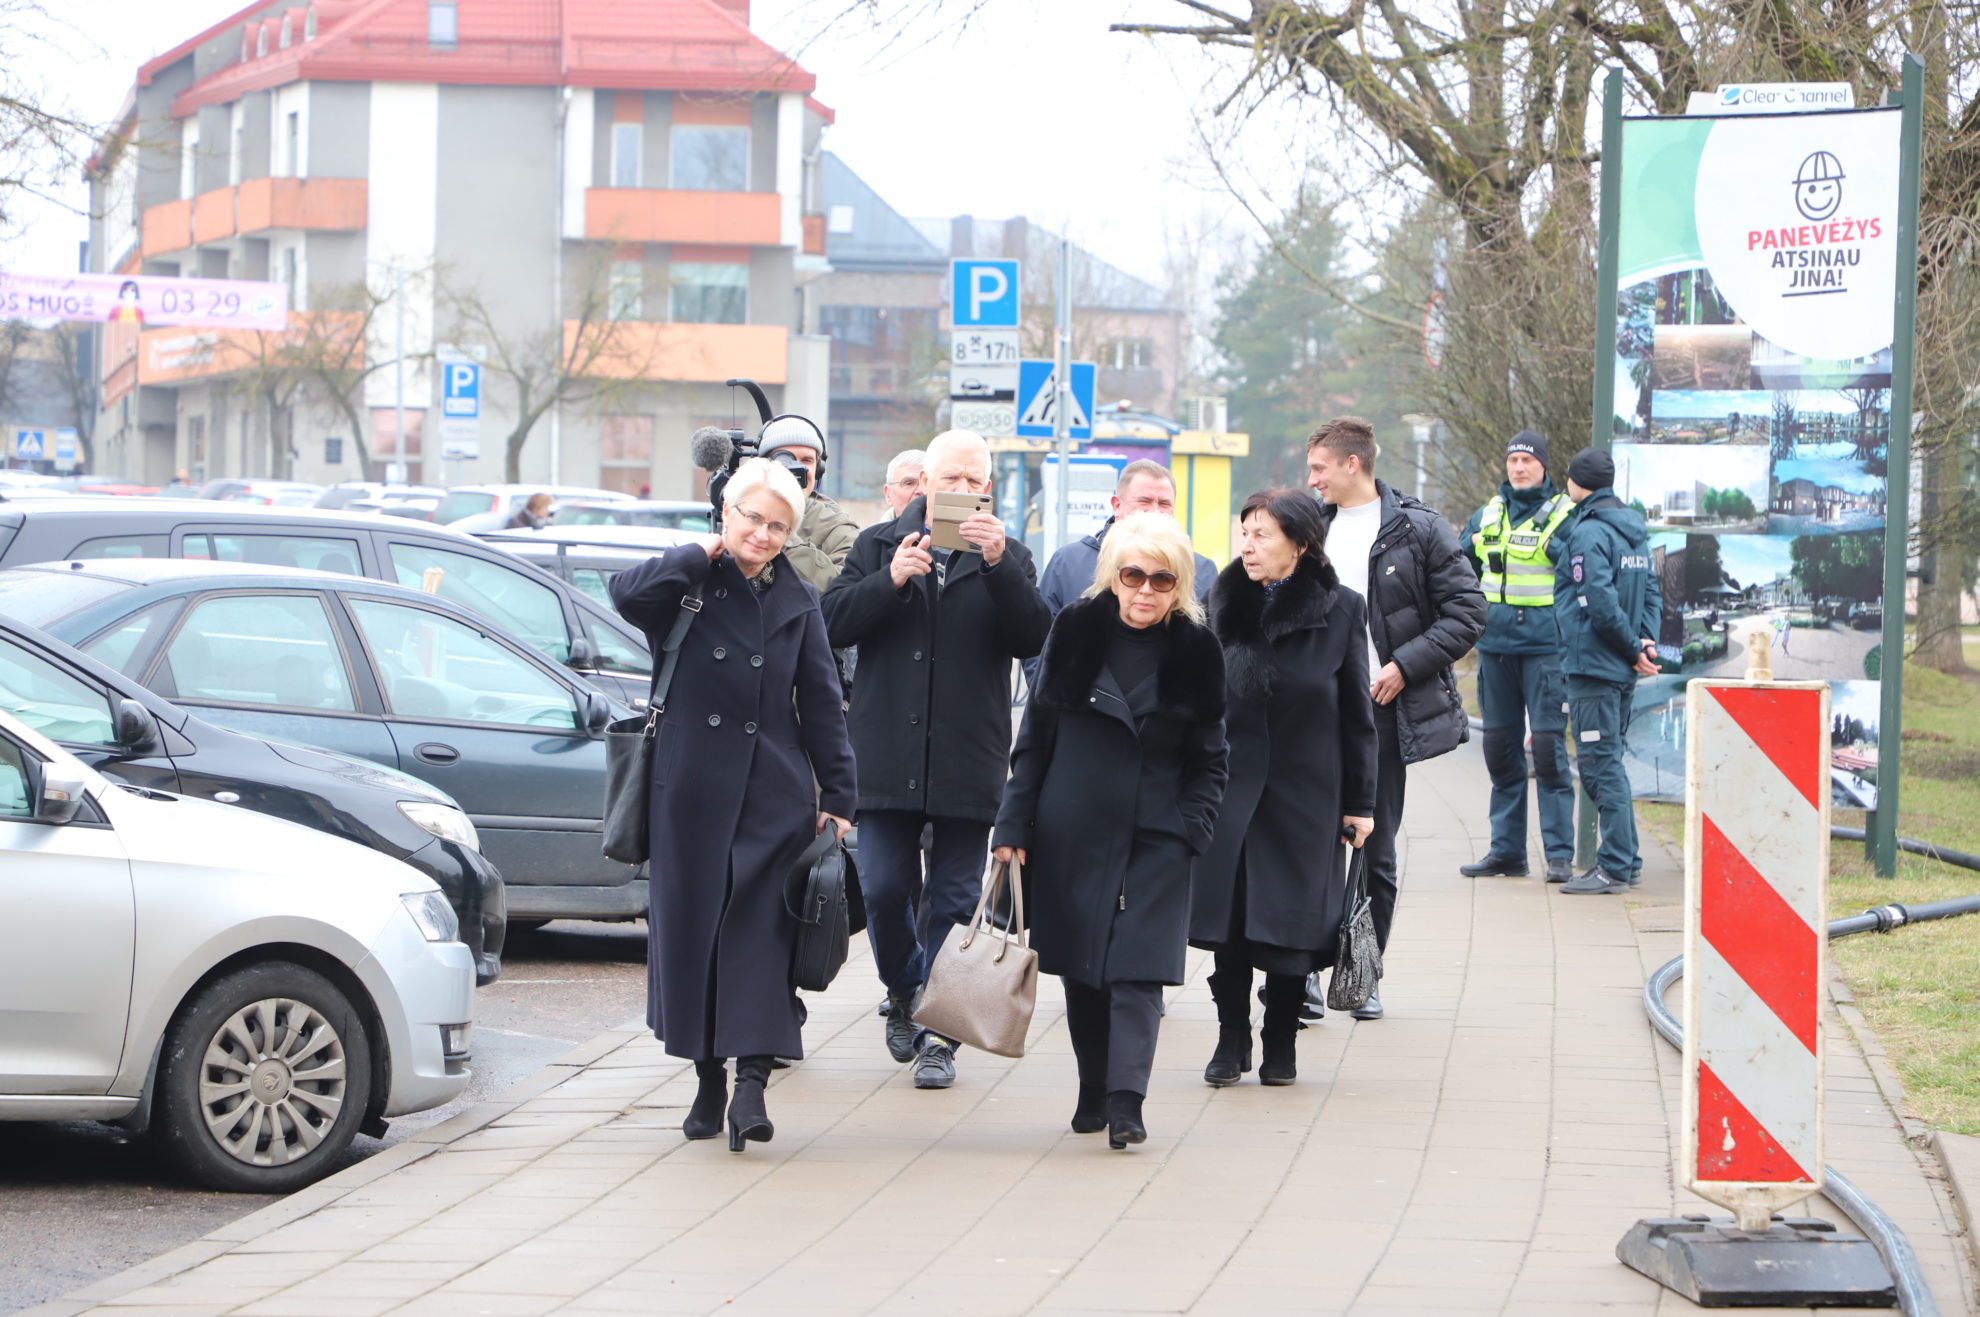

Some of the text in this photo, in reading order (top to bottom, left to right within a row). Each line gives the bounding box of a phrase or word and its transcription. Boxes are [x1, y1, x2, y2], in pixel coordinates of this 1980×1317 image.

[1747, 216, 1882, 251] PANEVĖŽYS
[1771, 248, 1861, 268] ATSINAU
[1789, 269, 1843, 288] JINA!
[161, 287, 196, 315] 03
[206, 290, 241, 318] 29
[970, 266, 1008, 321] P
[956, 343, 967, 360] 8
[985, 341, 1017, 360] 17h
[451, 365, 475, 397] P
[993, 413, 1012, 426] 50
